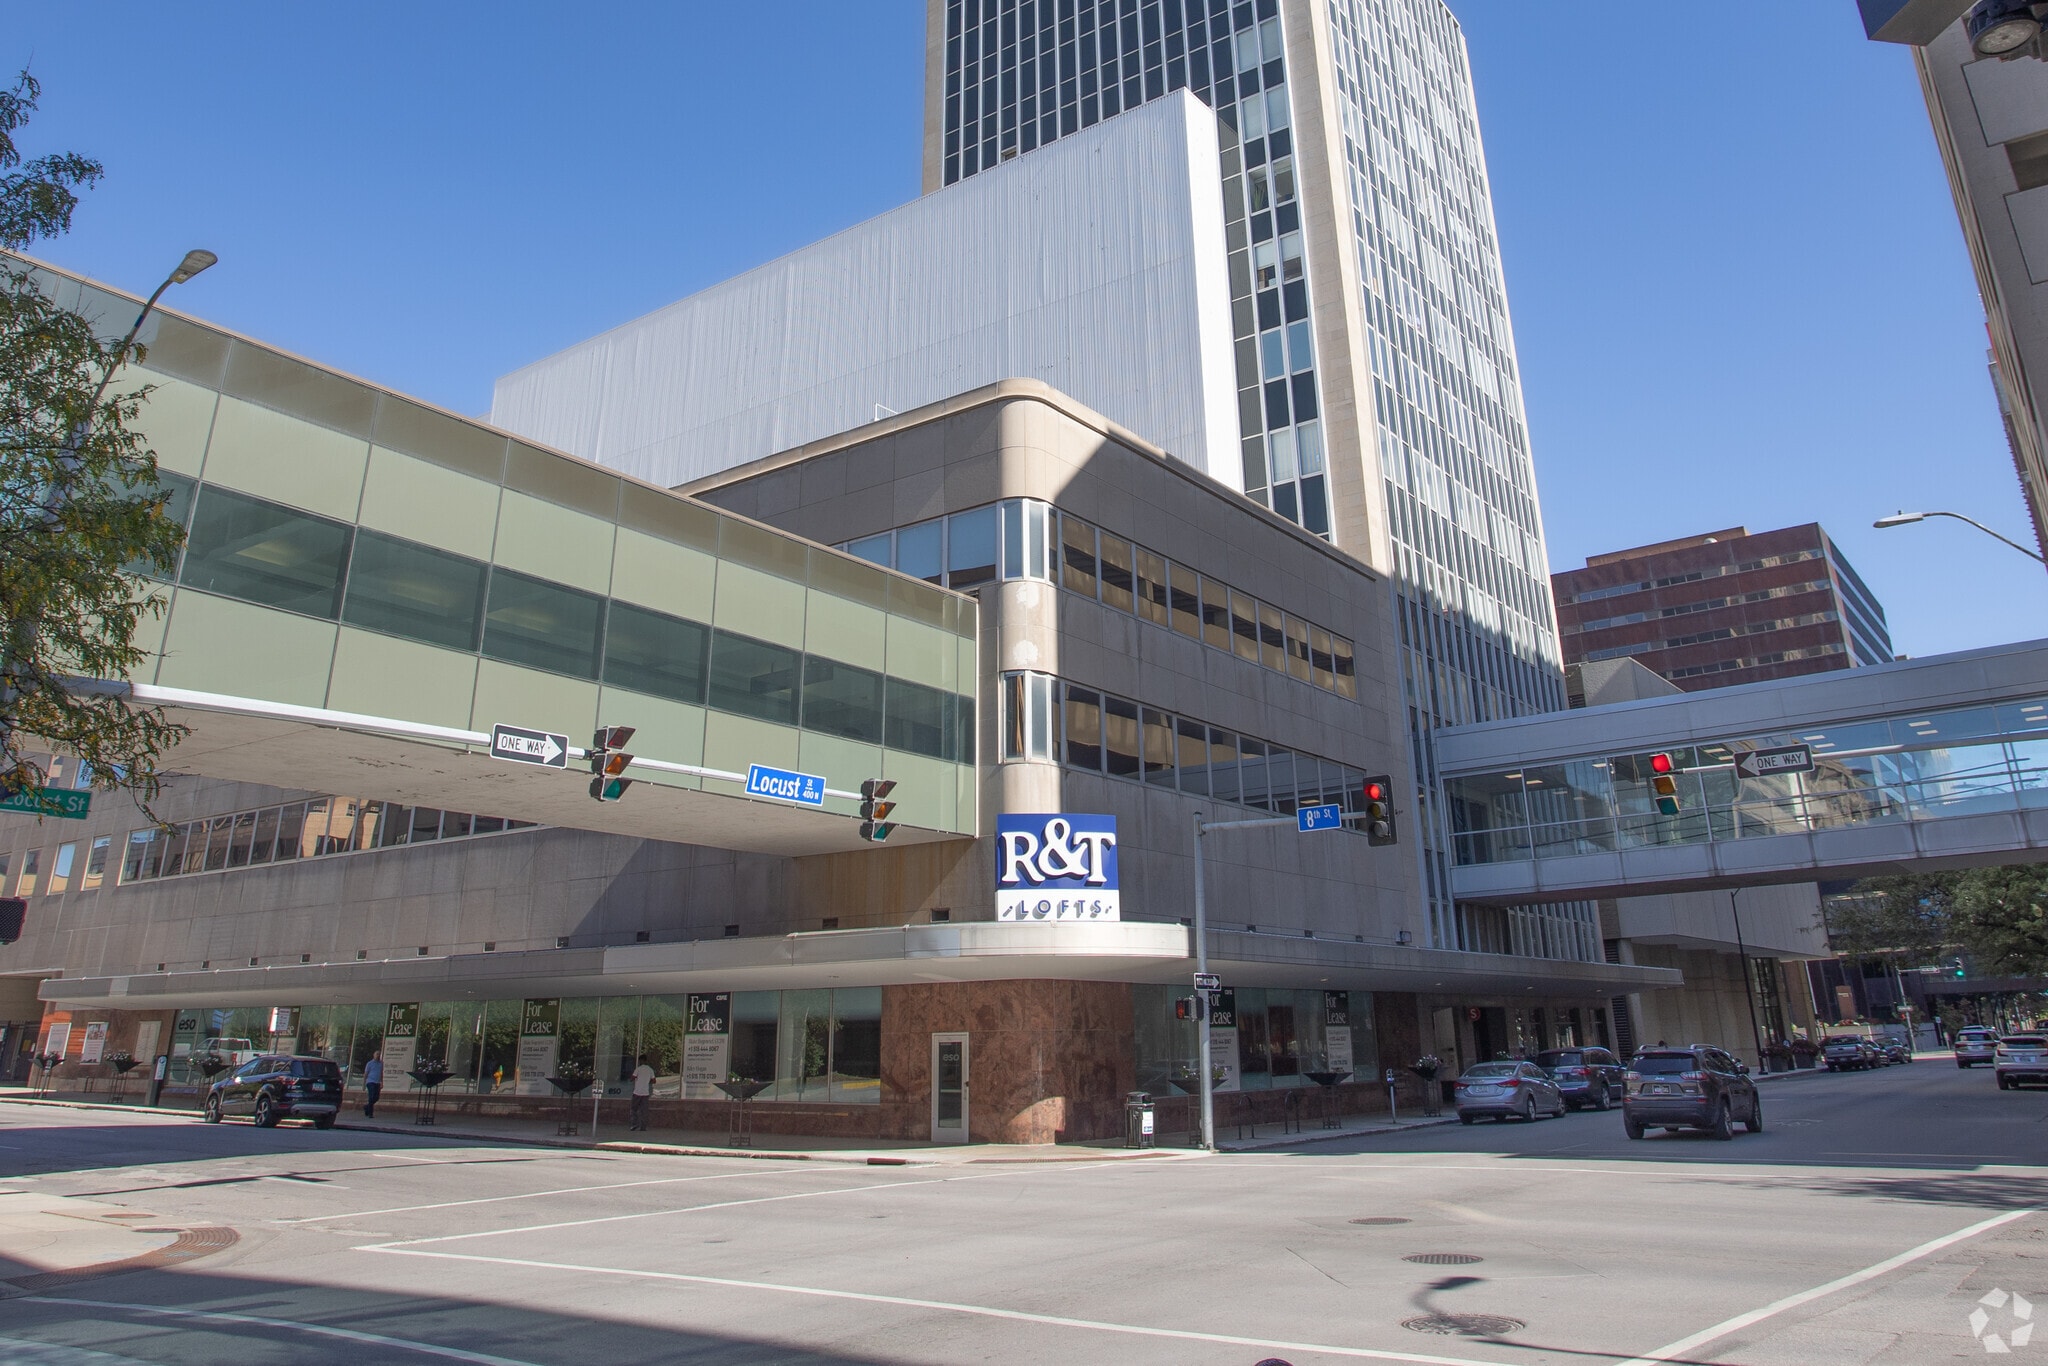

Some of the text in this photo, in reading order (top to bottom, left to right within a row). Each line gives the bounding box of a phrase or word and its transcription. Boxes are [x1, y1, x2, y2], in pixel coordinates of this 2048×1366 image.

[501, 735, 545, 755] ONE WAY
[1757, 753, 1802, 769] ONE WAY
[750, 768, 800, 798] Locust
[802, 790, 814, 800] 400
[66, 796, 86, 812] St
[1306, 810, 1320, 828] 8th
[1001, 818, 1116, 882] R&T
[1020, 900, 1102, 914] LOFTS
[690, 995, 709, 1013] For
[1209, 993, 1220, 1006] or
[1325, 992, 1336, 1008] For
[390, 1005, 405, 1020] For
[526, 1001, 542, 1017] For
[1327, 1008, 1346, 1024] Lease
[178, 1018, 196, 1030] eso
[388, 1020, 412, 1035] Lease
[524, 1018, 552, 1034] Lease
[689, 1014, 722, 1031] Lease
